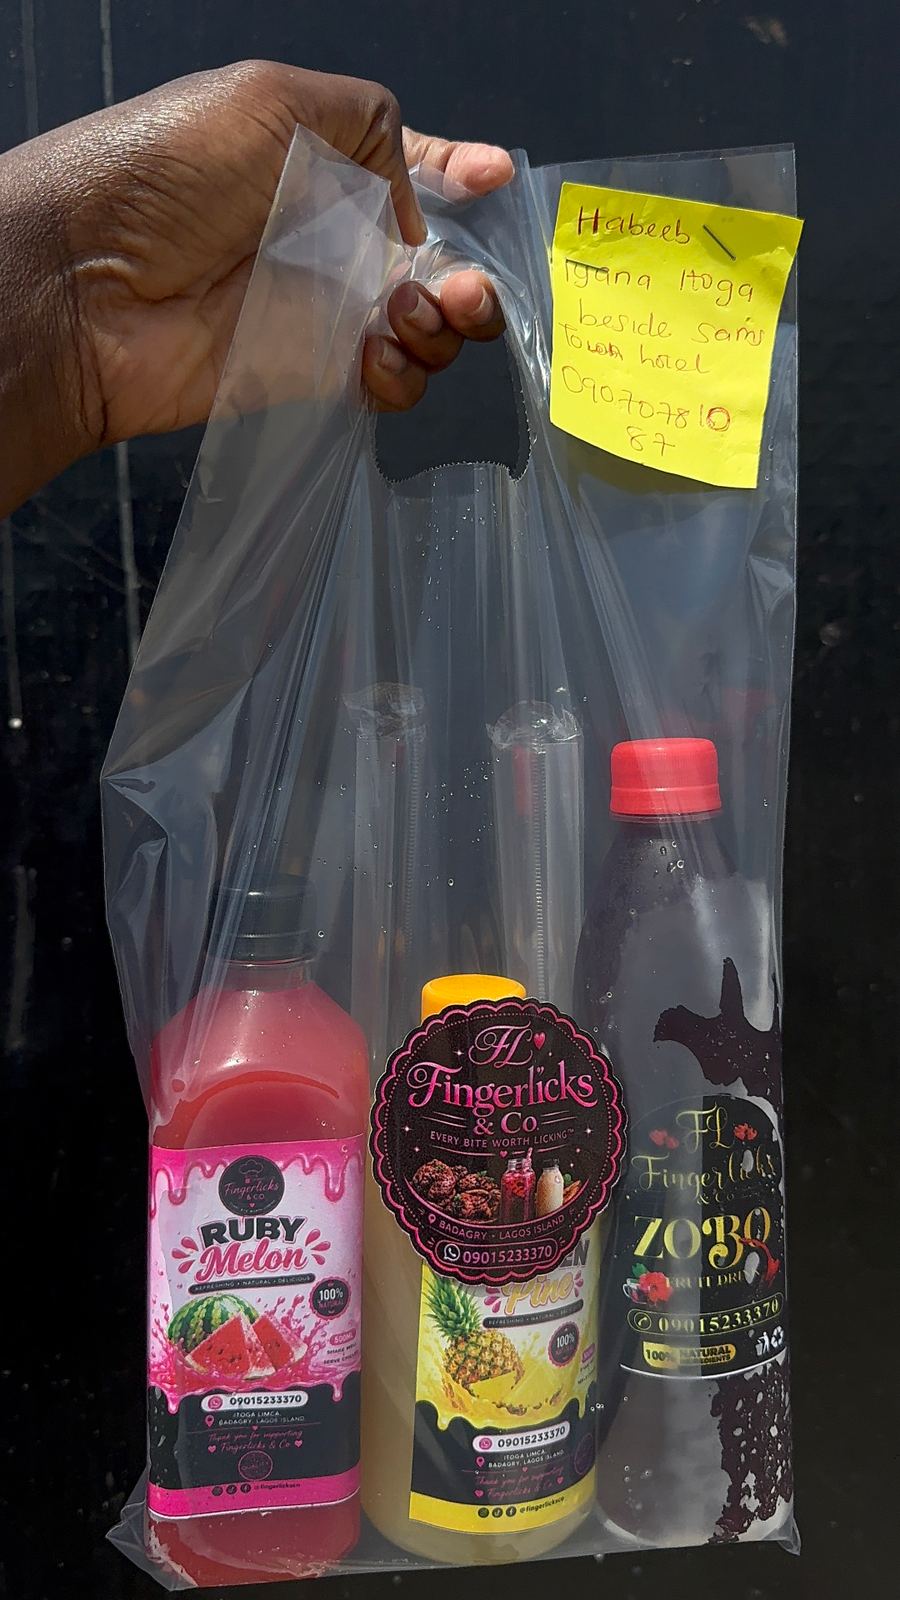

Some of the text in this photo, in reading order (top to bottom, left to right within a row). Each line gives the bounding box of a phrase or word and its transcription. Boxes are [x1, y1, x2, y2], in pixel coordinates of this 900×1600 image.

[577, 206, 690, 244] Habeeb
[579, 298, 672, 338] beside
[626, 426, 676, 456] 87
[473, 1118, 495, 1135] &
[430, 1130, 459, 1145] EVERY
[463, 1138, 488, 1148] BITE
[492, 1137, 530, 1148] WORTH
[201, 1218, 305, 1248] RUBY
[439, 1214, 565, 1240] BADAGRY LAGOS ISLAND
[634, 1206, 771, 1269] ZOBO
[195, 1238, 307, 1281] Melon
[463, 1245, 552, 1264] 09015233370
[319, 1288, 344, 1300] 100%
[658, 1298, 780, 1333] 09015233370
[556, 1333, 575, 1348] 100%
[229, 1394, 302, 1406] 09015233370
[497, 1425, 566, 1448] 09015233370
[504, 1453, 524, 1461] ITOGA
[523, 1457, 545, 1465] LAGOS
